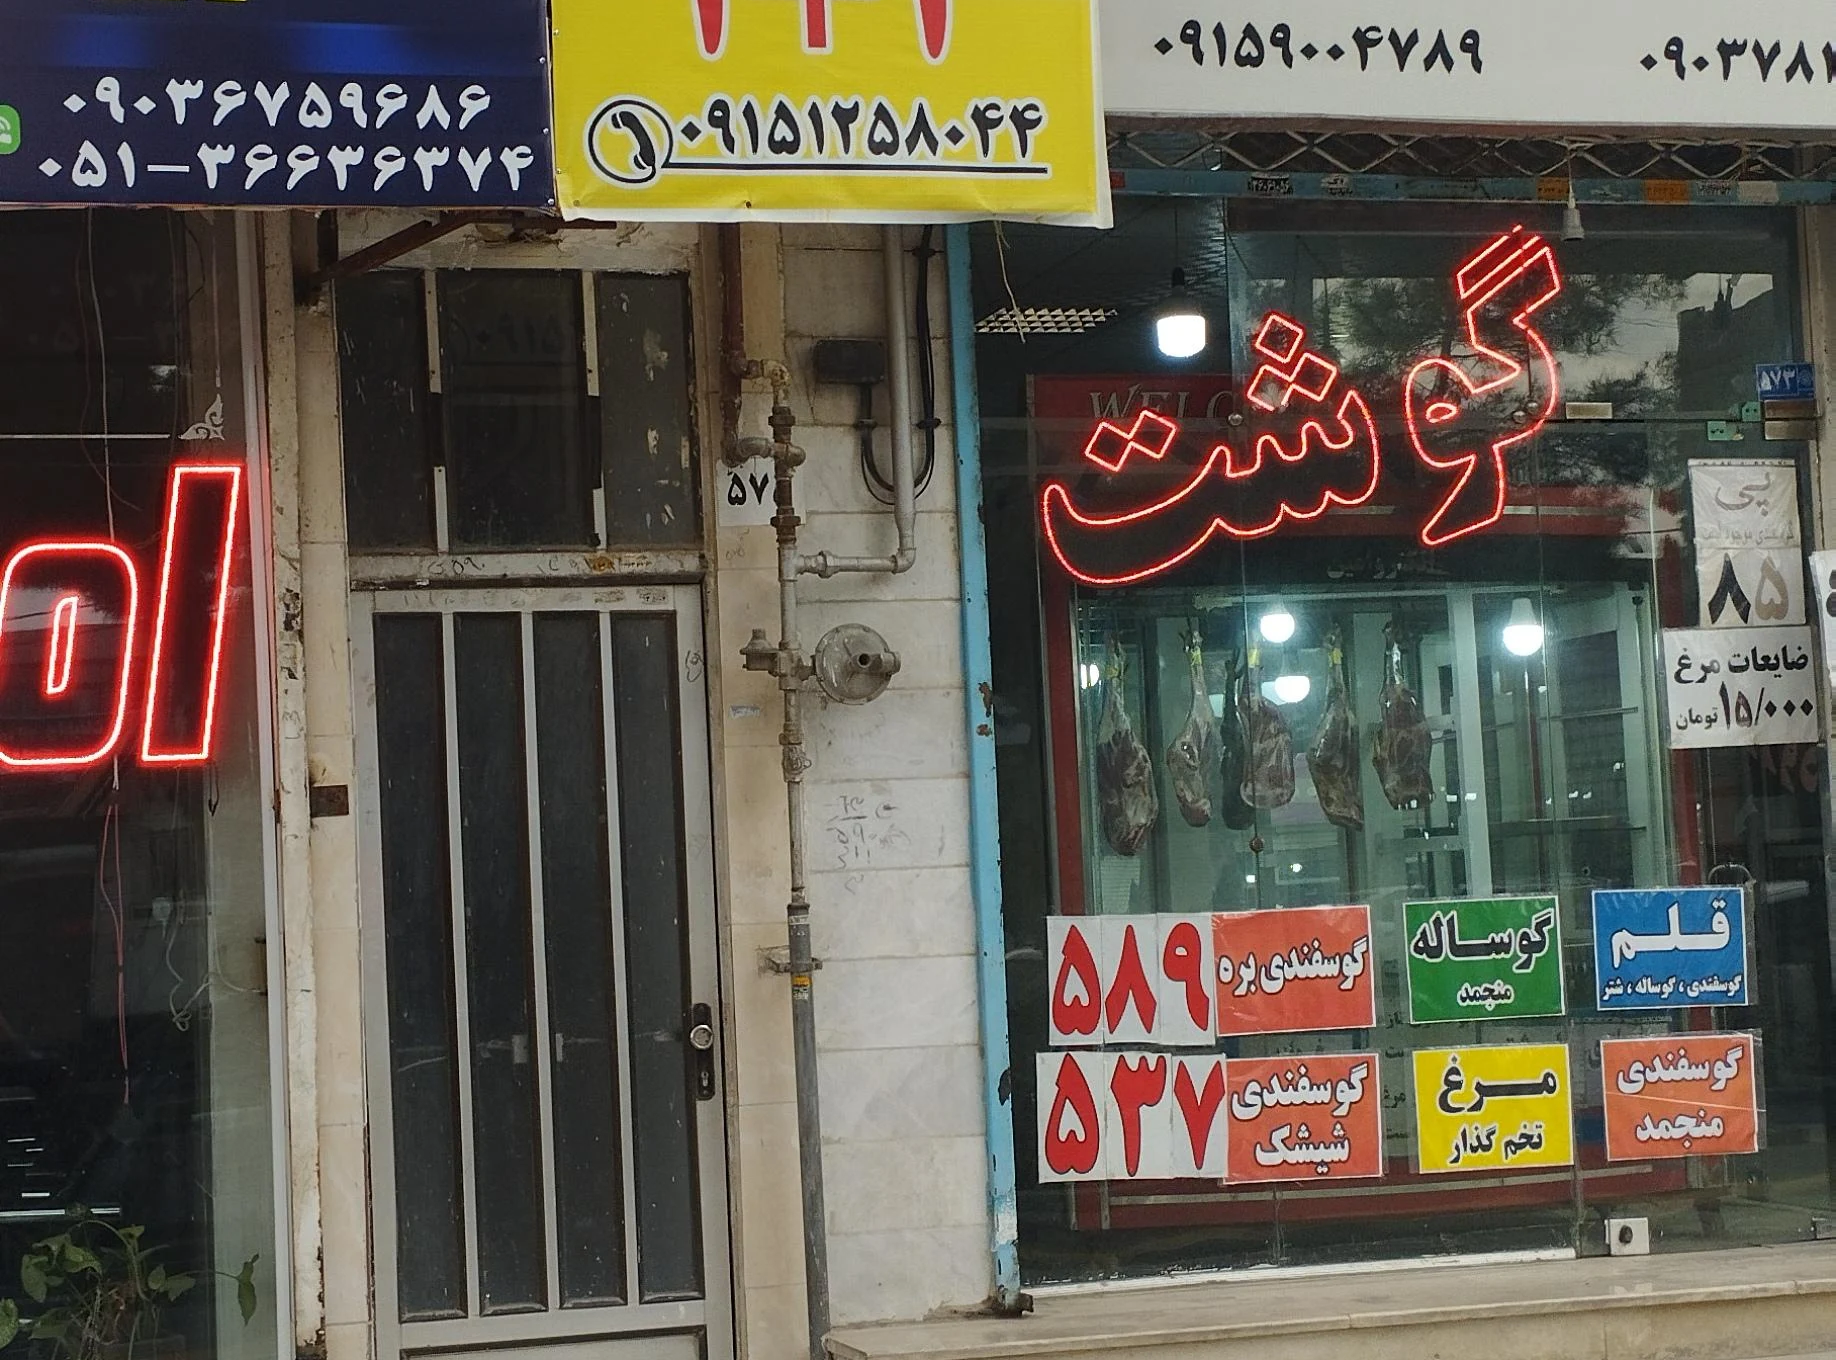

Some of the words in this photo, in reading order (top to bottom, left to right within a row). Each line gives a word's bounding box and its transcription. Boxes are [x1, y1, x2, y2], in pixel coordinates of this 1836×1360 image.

[1153, 19, 1484, 77] ۰۹۱۵۹۰۰۴۷۸۹
[62, 75, 491, 132] ۰۹۰۳۶۷۵۹۶۸۶
[678, 95, 1046, 161] ۰۹۱۵۱۲۵۸۰۴۴
[39, 139, 534, 193] ۰۵۱-۳۶۶۳۶۳۷۴
[1041, 224, 1563, 586] گوشت
[727, 472, 770, 506] ۵۷
[0, 463, 242, 767] ام
[1674, 647, 1721, 684] مرغ
[1728, 644, 1809, 679] ضایعات
[1675, 706, 1719, 731] تومان
[1410, 907, 1555, 974] گوساله
[1611, 897, 1731, 969] قلم
[1052, 922, 1210, 1036] ۵۸۹
[1218, 952, 1257, 997] بره
[1260, 934, 1369, 995] گوسفندی
[1601, 976, 1625, 1002] شتر
[1457, 980, 1515, 1011] منجمد
[1231, 1061, 1370, 1122] گوسفندی
[1437, 1054, 1558, 1115] مرغ
[1616, 1044, 1745, 1095] گوسفندی
[1045, 1052, 1226, 1177] ۵۳۷
[1635, 1109, 1726, 1149] منجمد
[1254, 1121, 1351, 1175] شیشک
[1448, 1124, 1498, 1165] گذار
[1503, 1123, 1544, 1161] تخم
